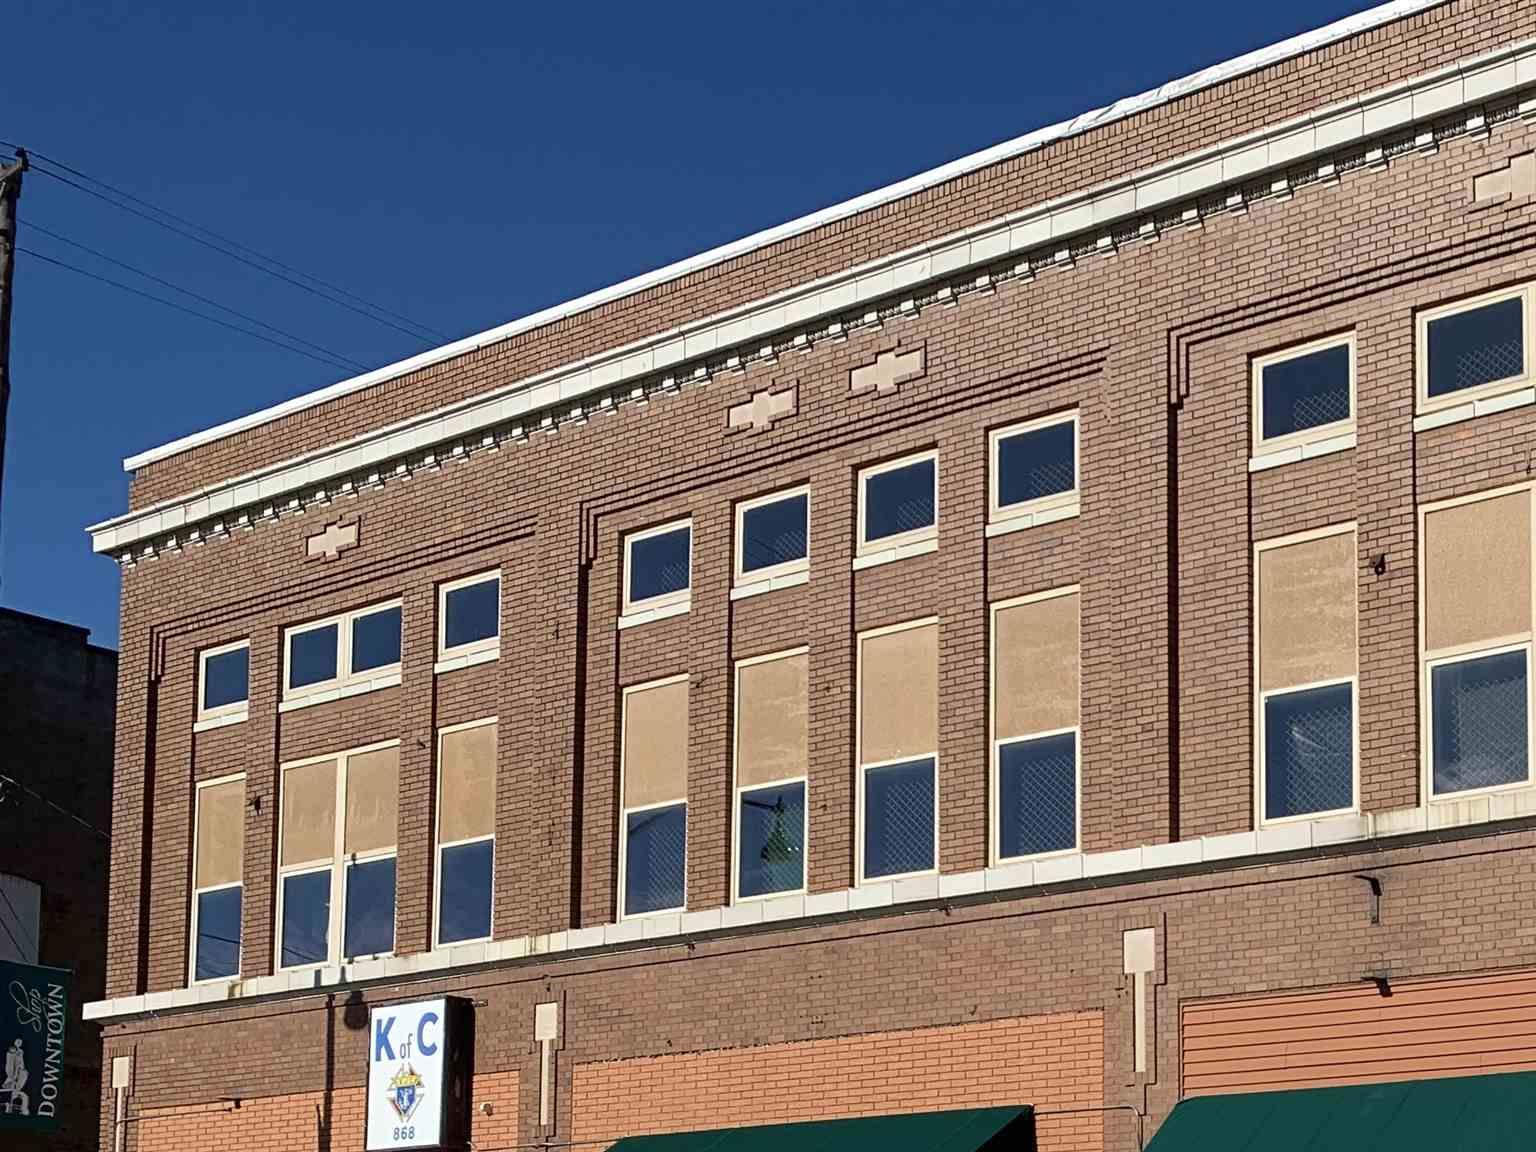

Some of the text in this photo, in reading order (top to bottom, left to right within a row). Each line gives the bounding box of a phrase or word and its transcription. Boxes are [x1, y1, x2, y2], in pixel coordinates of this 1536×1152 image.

[9, 980, 50, 1032] Shop
[37, 983, 64, 1118] DOWNTOWN
[375, 1012, 439, 1062] K of C
[393, 1126, 415, 1141] 868
